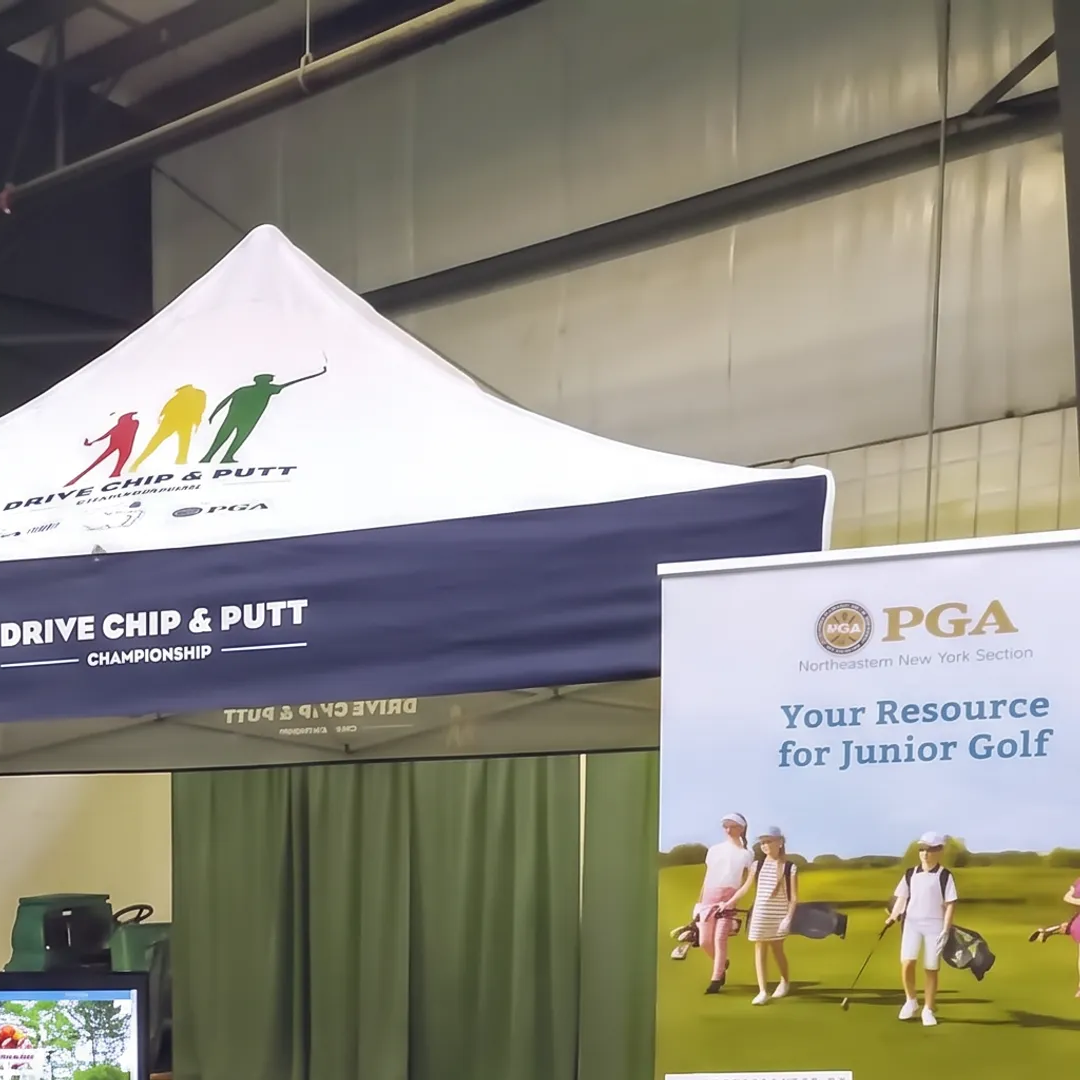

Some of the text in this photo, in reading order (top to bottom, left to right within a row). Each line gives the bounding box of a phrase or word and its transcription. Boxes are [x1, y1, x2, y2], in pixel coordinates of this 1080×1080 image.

[2, 486, 93, 511] DRIVE
[101, 473, 175, 491] CHIP
[181, 471, 203, 481] &
[211, 466, 298, 480] PUTT
[207, 503, 269, 514] PGA
[0, 599, 308, 647] DRIVE CHIP & PUTT
[881, 599, 1019, 643] PGA
[87, 645, 212, 667] CHAMPIONSHIP
[799, 647, 1034, 672] Northeastern New York Section
[780, 697, 1050, 729] Your Resource
[779, 729, 1054, 771] for Junior Golf
